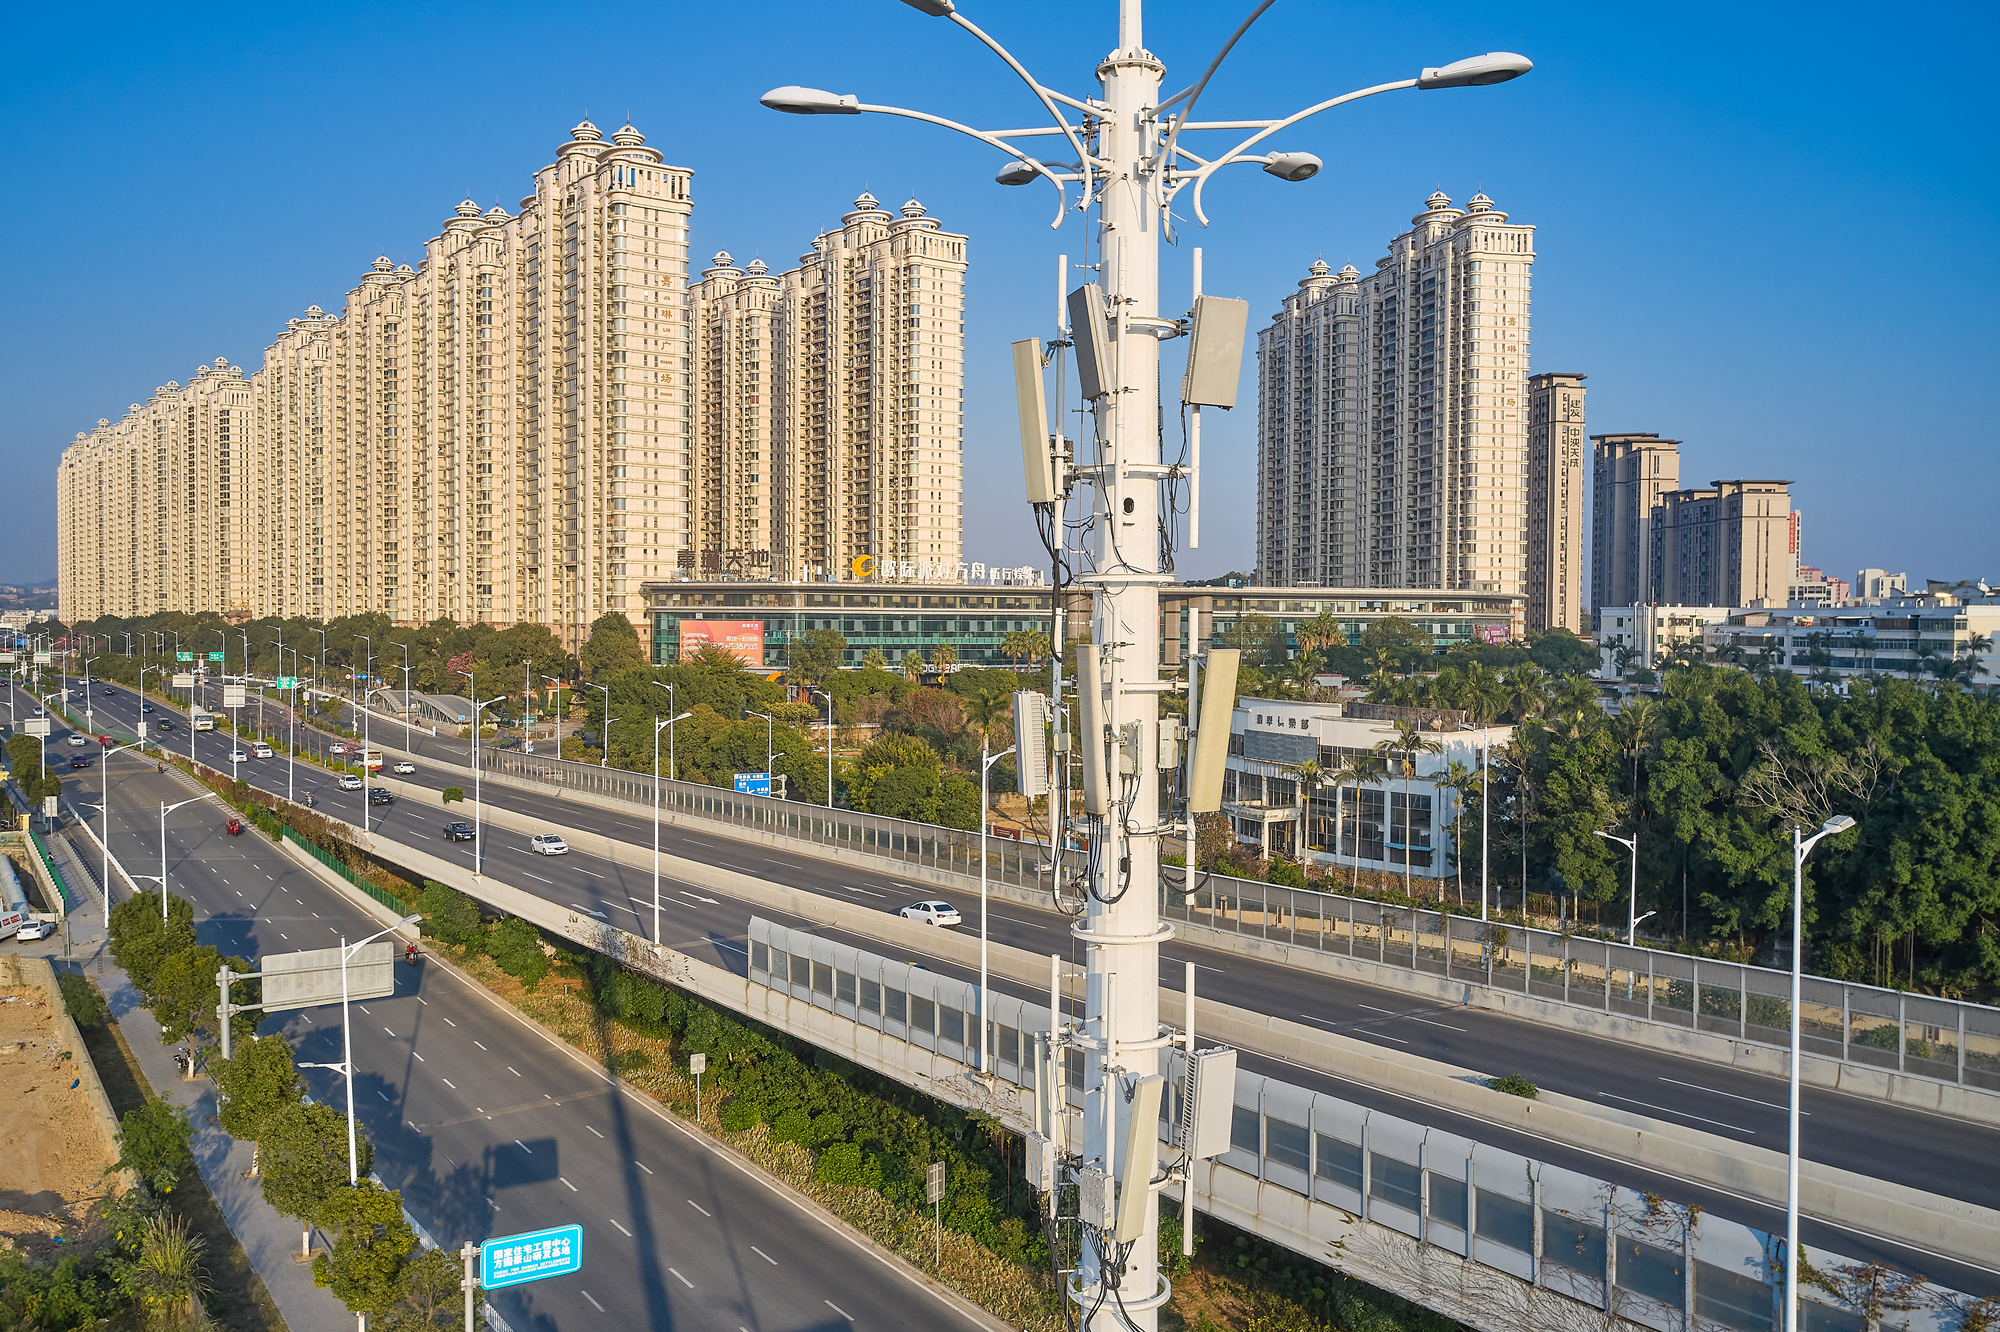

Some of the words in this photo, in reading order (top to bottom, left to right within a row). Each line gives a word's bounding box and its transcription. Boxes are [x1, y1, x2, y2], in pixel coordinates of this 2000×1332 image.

[1570, 399, 1580, 417] 建发
[493, 1237, 570, 1260] 国家住宅工程中心
